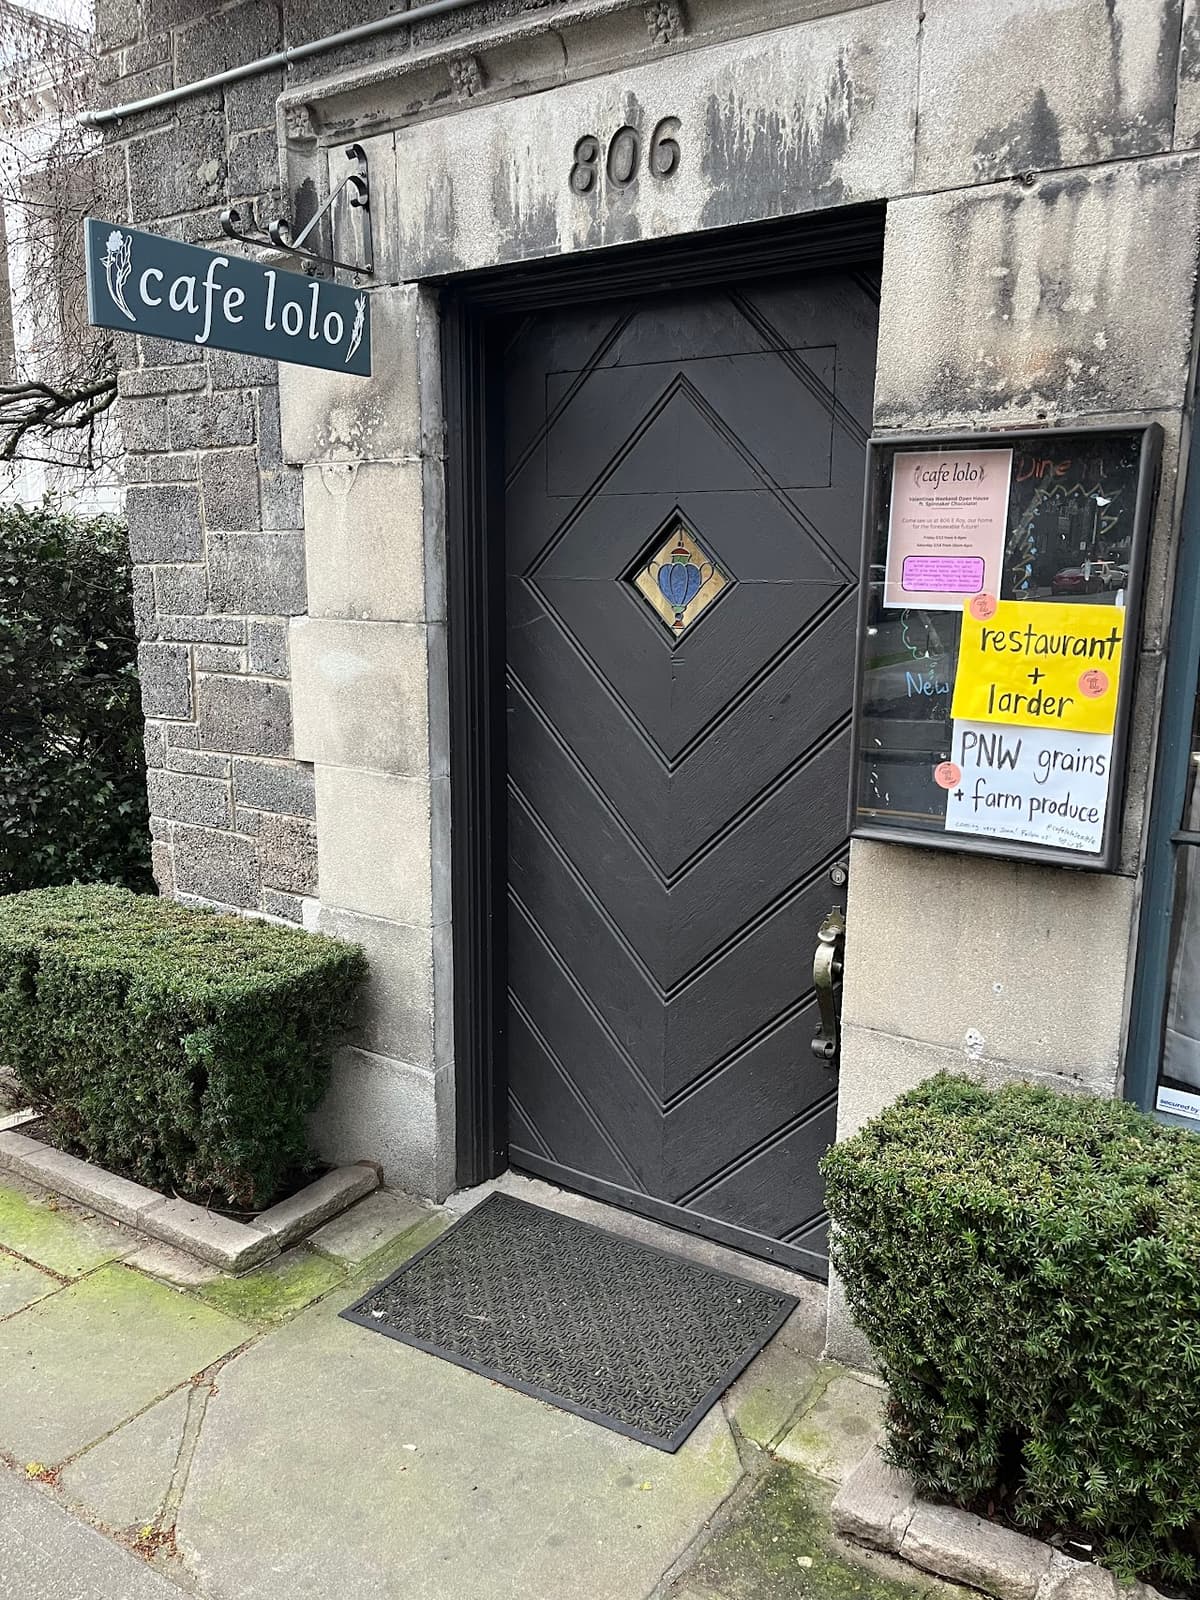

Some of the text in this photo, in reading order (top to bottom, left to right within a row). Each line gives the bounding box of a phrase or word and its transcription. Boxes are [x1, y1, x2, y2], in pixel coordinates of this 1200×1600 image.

[568, 115, 682, 197] 806
[139, 256, 345, 346] cafe lolo
[922, 462, 978, 490] cafe lolo
[980, 623, 1123, 661] restaurant
[905, 671, 950, 698] New
[988, 684, 1074, 718] larder
[960, 730, 1106, 784] PNW grains
[971, 777, 1022, 813] farm
[1028, 791, 1100, 824] produce
[1160, 1099, 1190, 1111] secured
